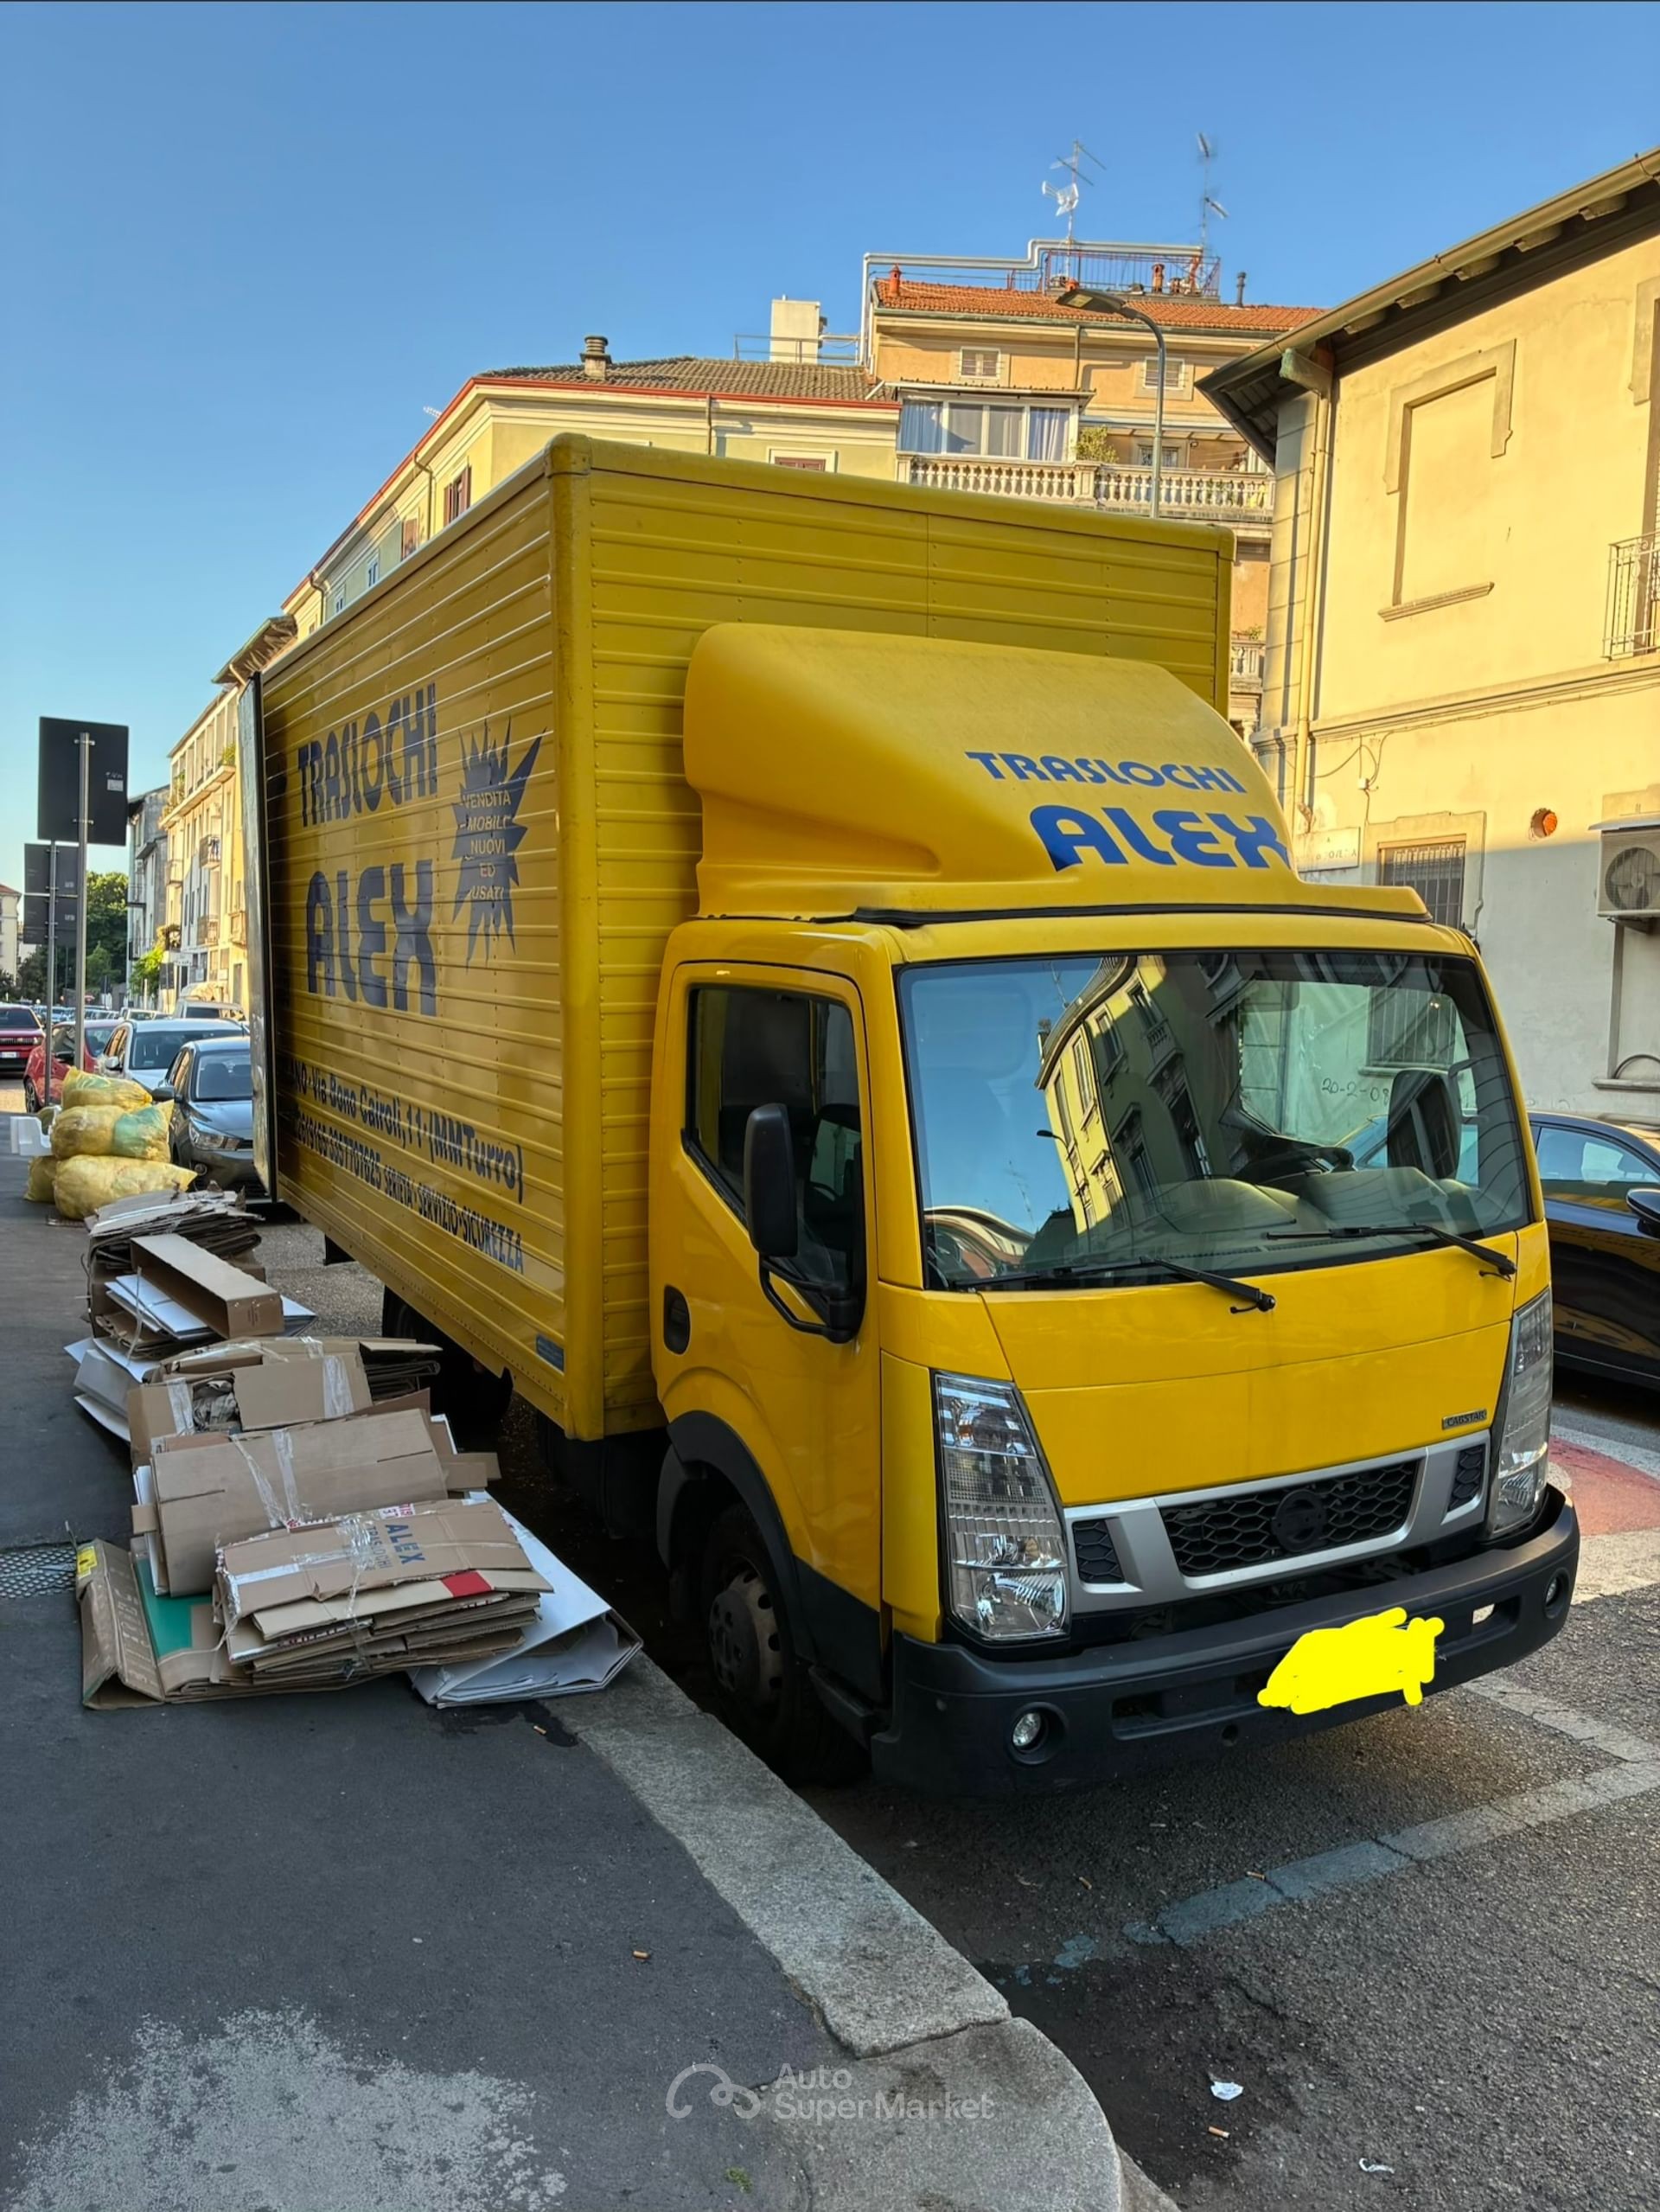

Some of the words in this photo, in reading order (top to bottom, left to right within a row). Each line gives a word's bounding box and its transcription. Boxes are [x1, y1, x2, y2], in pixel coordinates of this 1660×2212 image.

[298, 682, 437, 828] TRASLOCHI
[965, 751, 1248, 793] TRASLOCHI
[463, 790, 511, 809] VENDITA
[470, 839, 506, 855] NUOVI
[1030, 804, 1291, 871] ALEX
[480, 862, 495, 877] ED
[470, 885, 504, 901] USATI
[306, 860, 437, 1017] ALEX
[385, 1524, 427, 1565] ALEX
